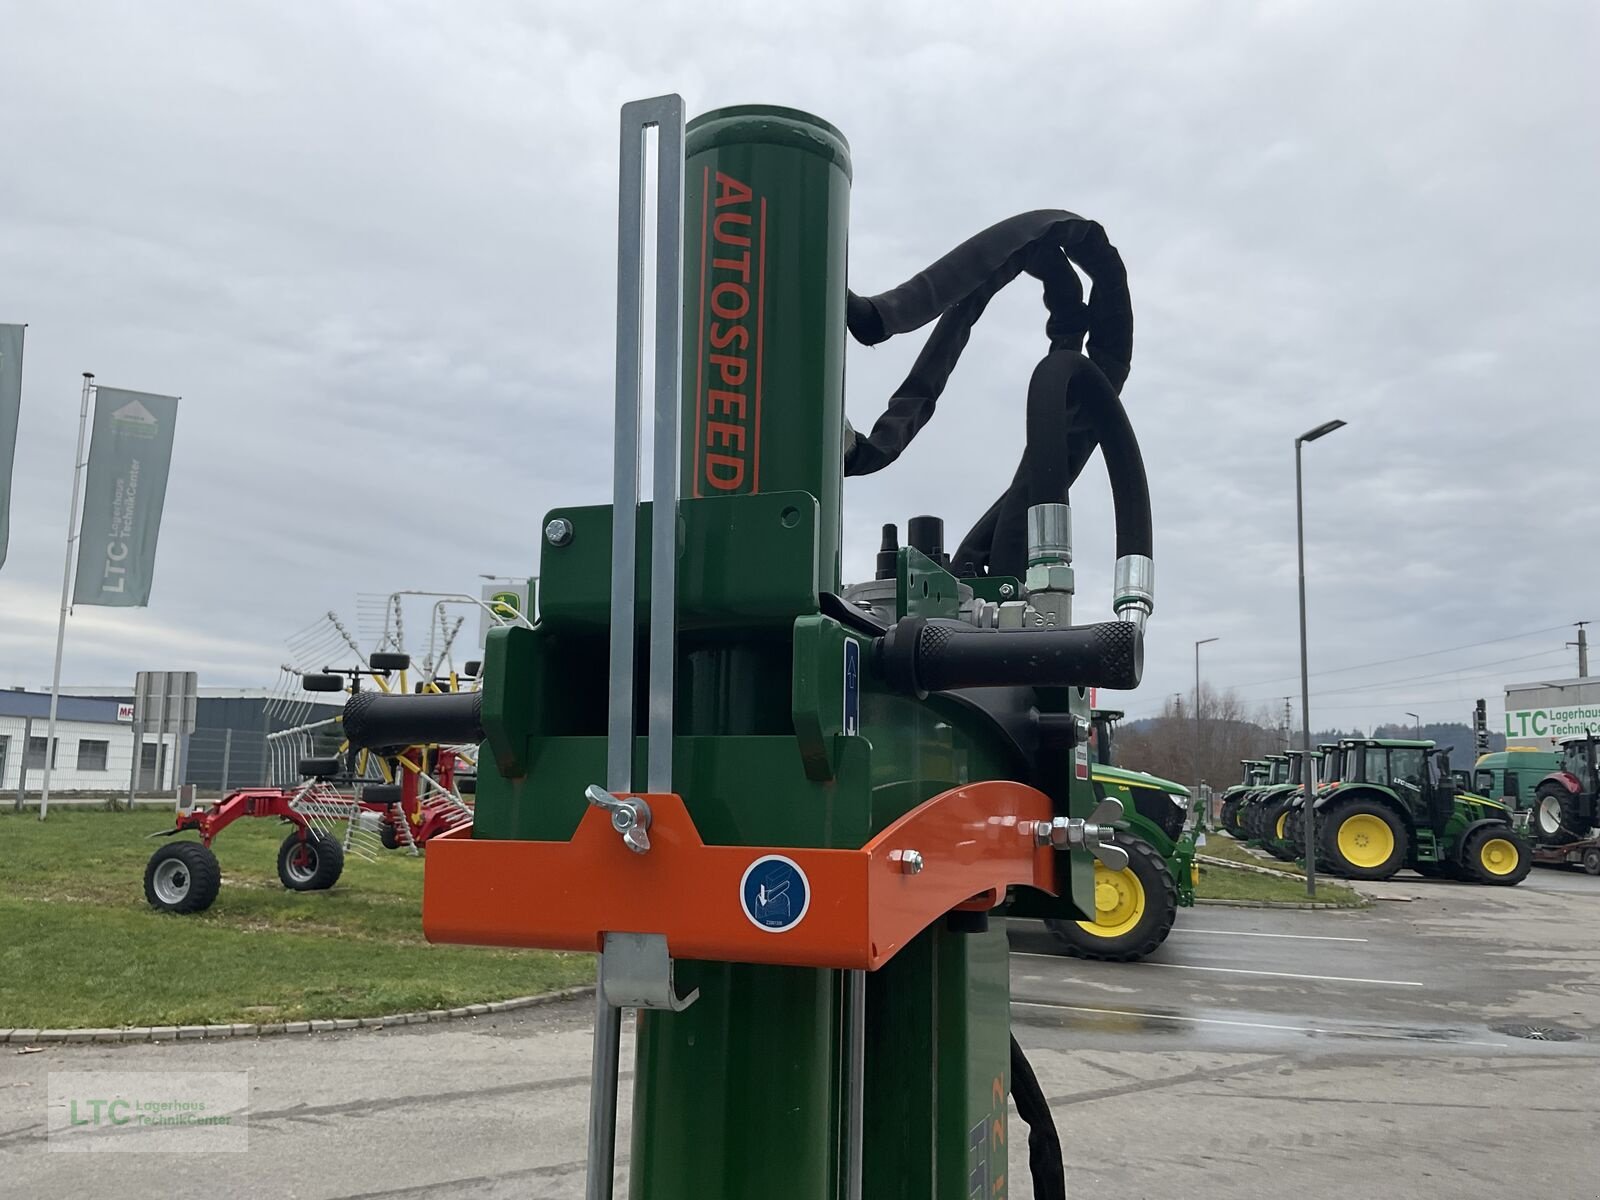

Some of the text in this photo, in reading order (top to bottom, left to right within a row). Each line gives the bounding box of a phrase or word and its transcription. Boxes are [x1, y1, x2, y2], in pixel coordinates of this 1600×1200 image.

[705, 171, 753, 490] AUTOSPEED
[108, 477, 124, 537] Lagerhaus
[120, 458, 140, 538] TechnikCenter
[102, 541, 128, 593] LTC
[1505, 710, 1548, 737] LTC
